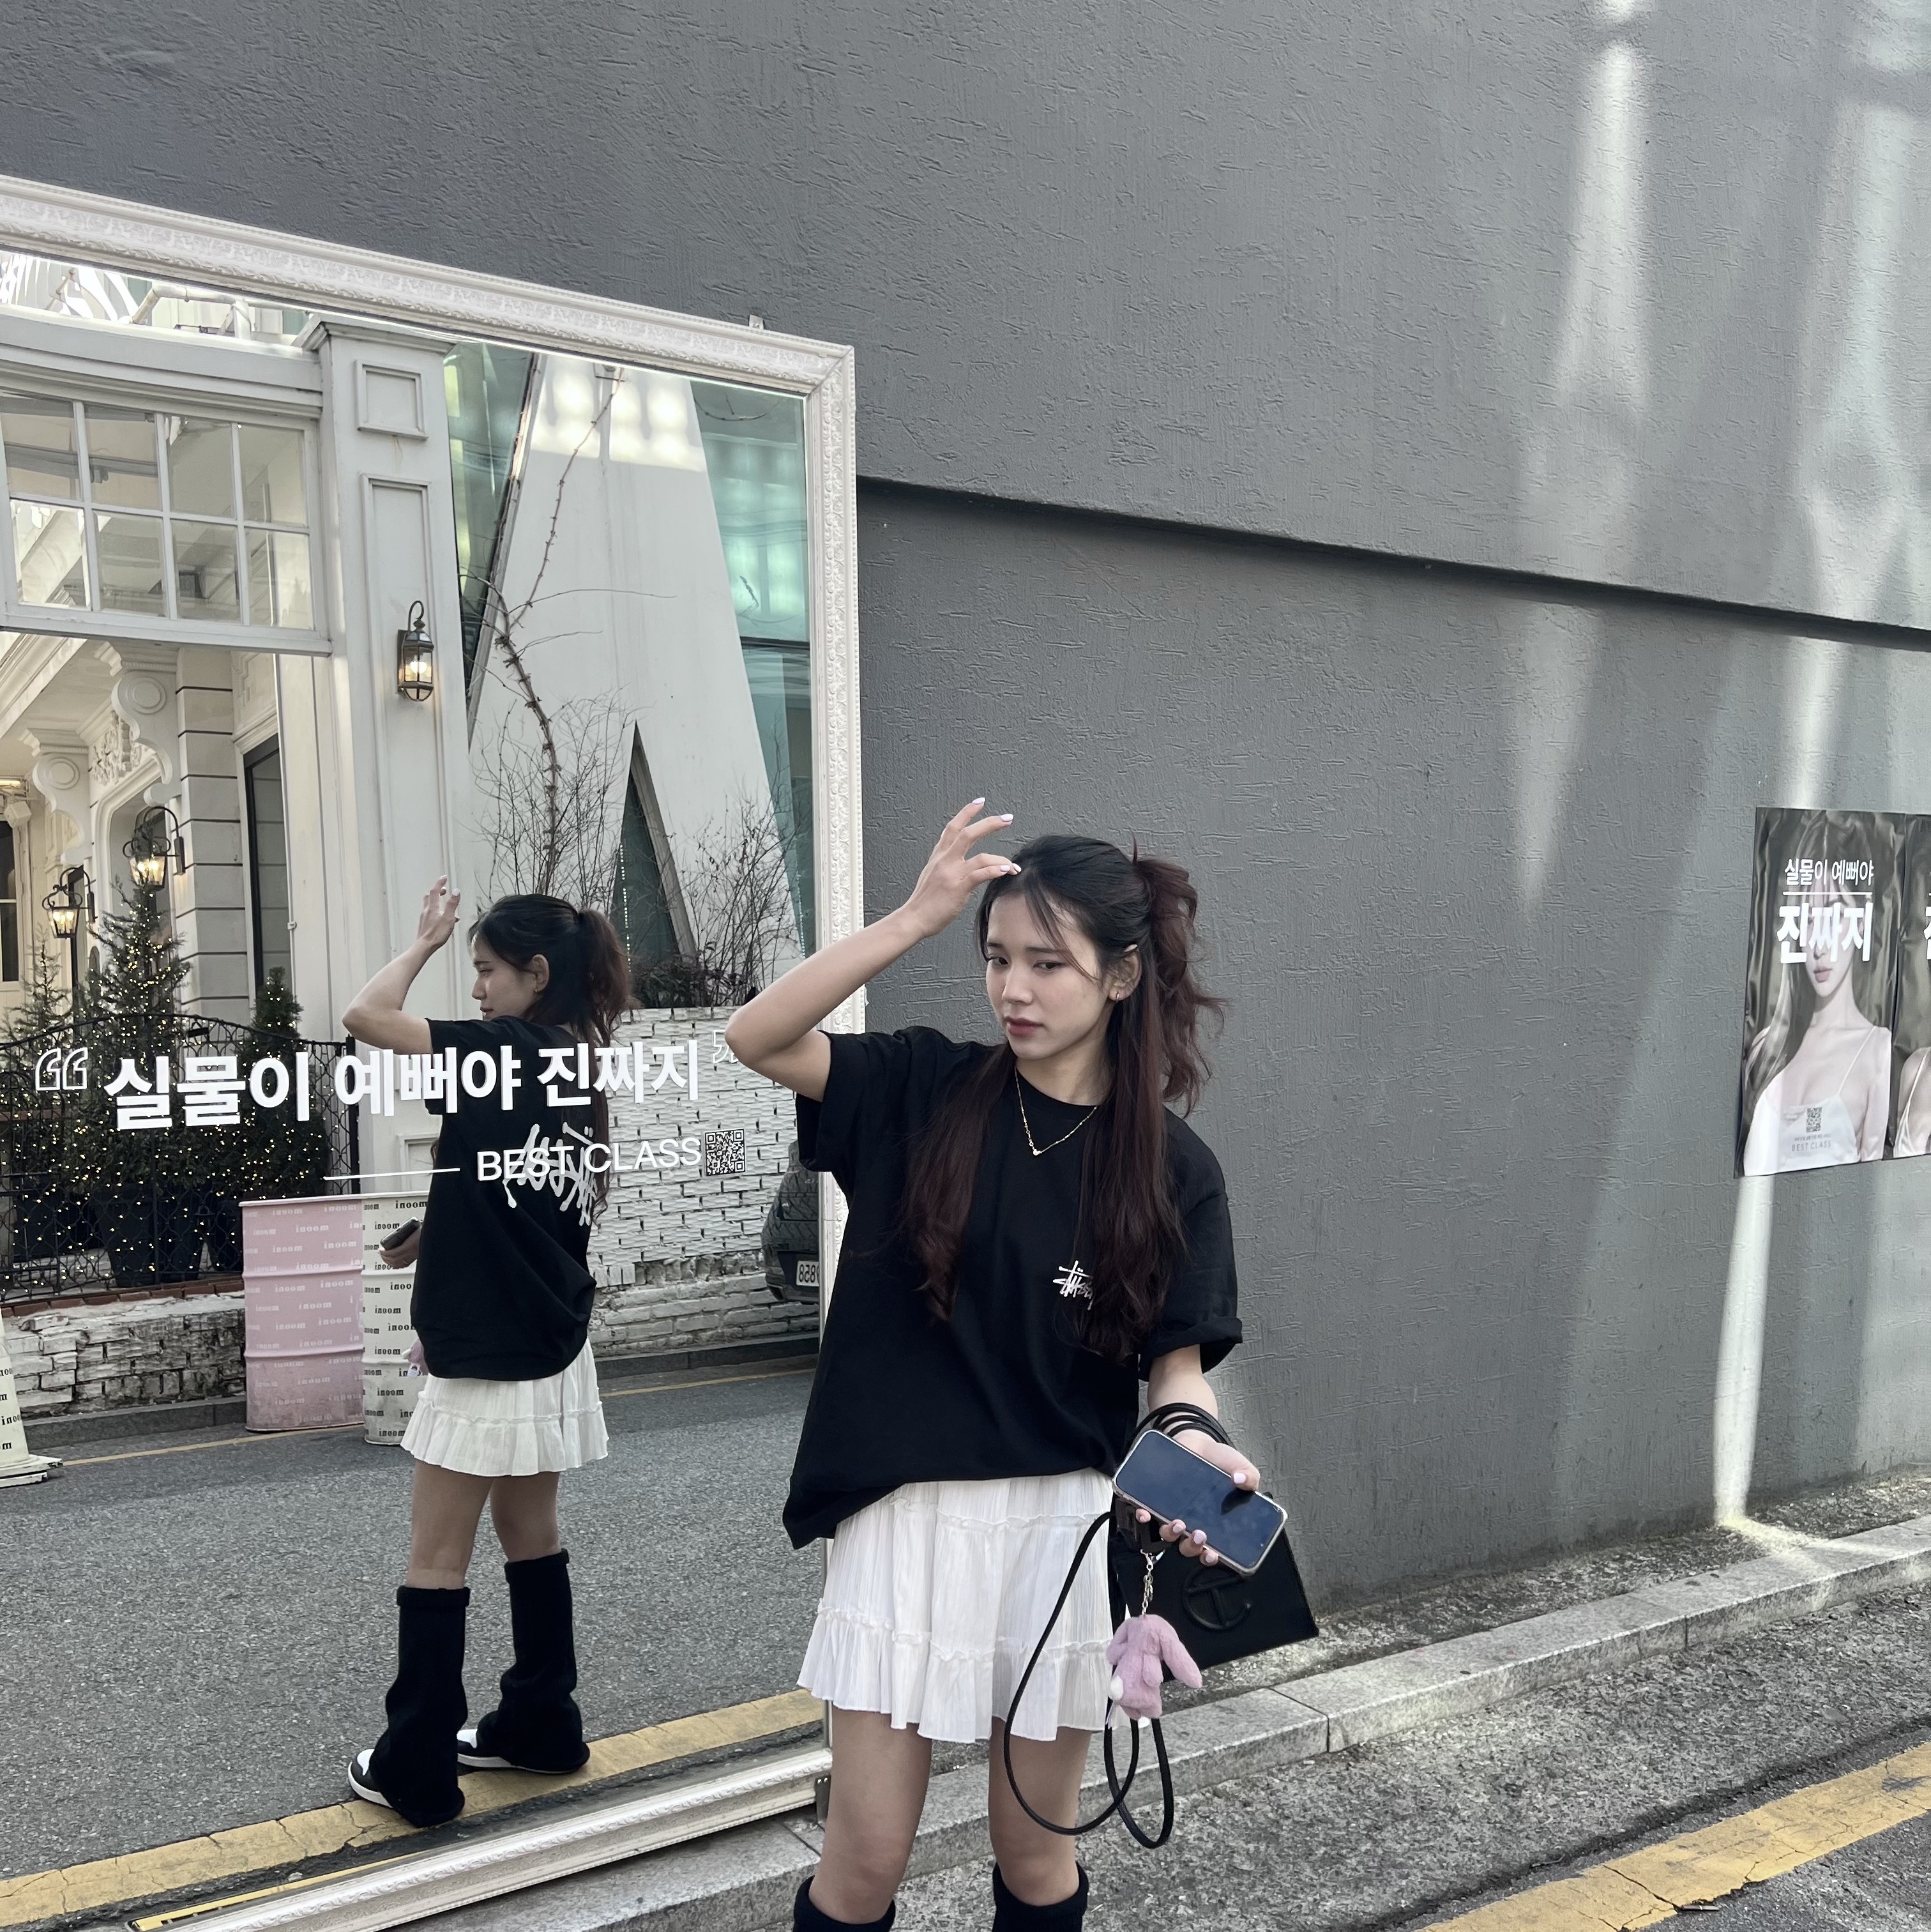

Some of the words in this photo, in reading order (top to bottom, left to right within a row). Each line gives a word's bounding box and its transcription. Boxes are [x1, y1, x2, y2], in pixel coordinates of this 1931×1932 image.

[1785, 858, 1828, 885] 실물이
[1831, 860, 1874, 885] 예뻐야
[1777, 902, 1874, 963] 진짜지
[105, 1052, 310, 1129] 실물이
[335, 1048, 521, 1116] 예뻐야
[538, 1040, 699, 1107] 진짜지
[477, 1145, 575, 1181] BEST
[584, 1137, 702, 1173] CLASS
[1792, 1143, 1808, 1152] BEST
[1810, 1141, 1831, 1149] CLASS
